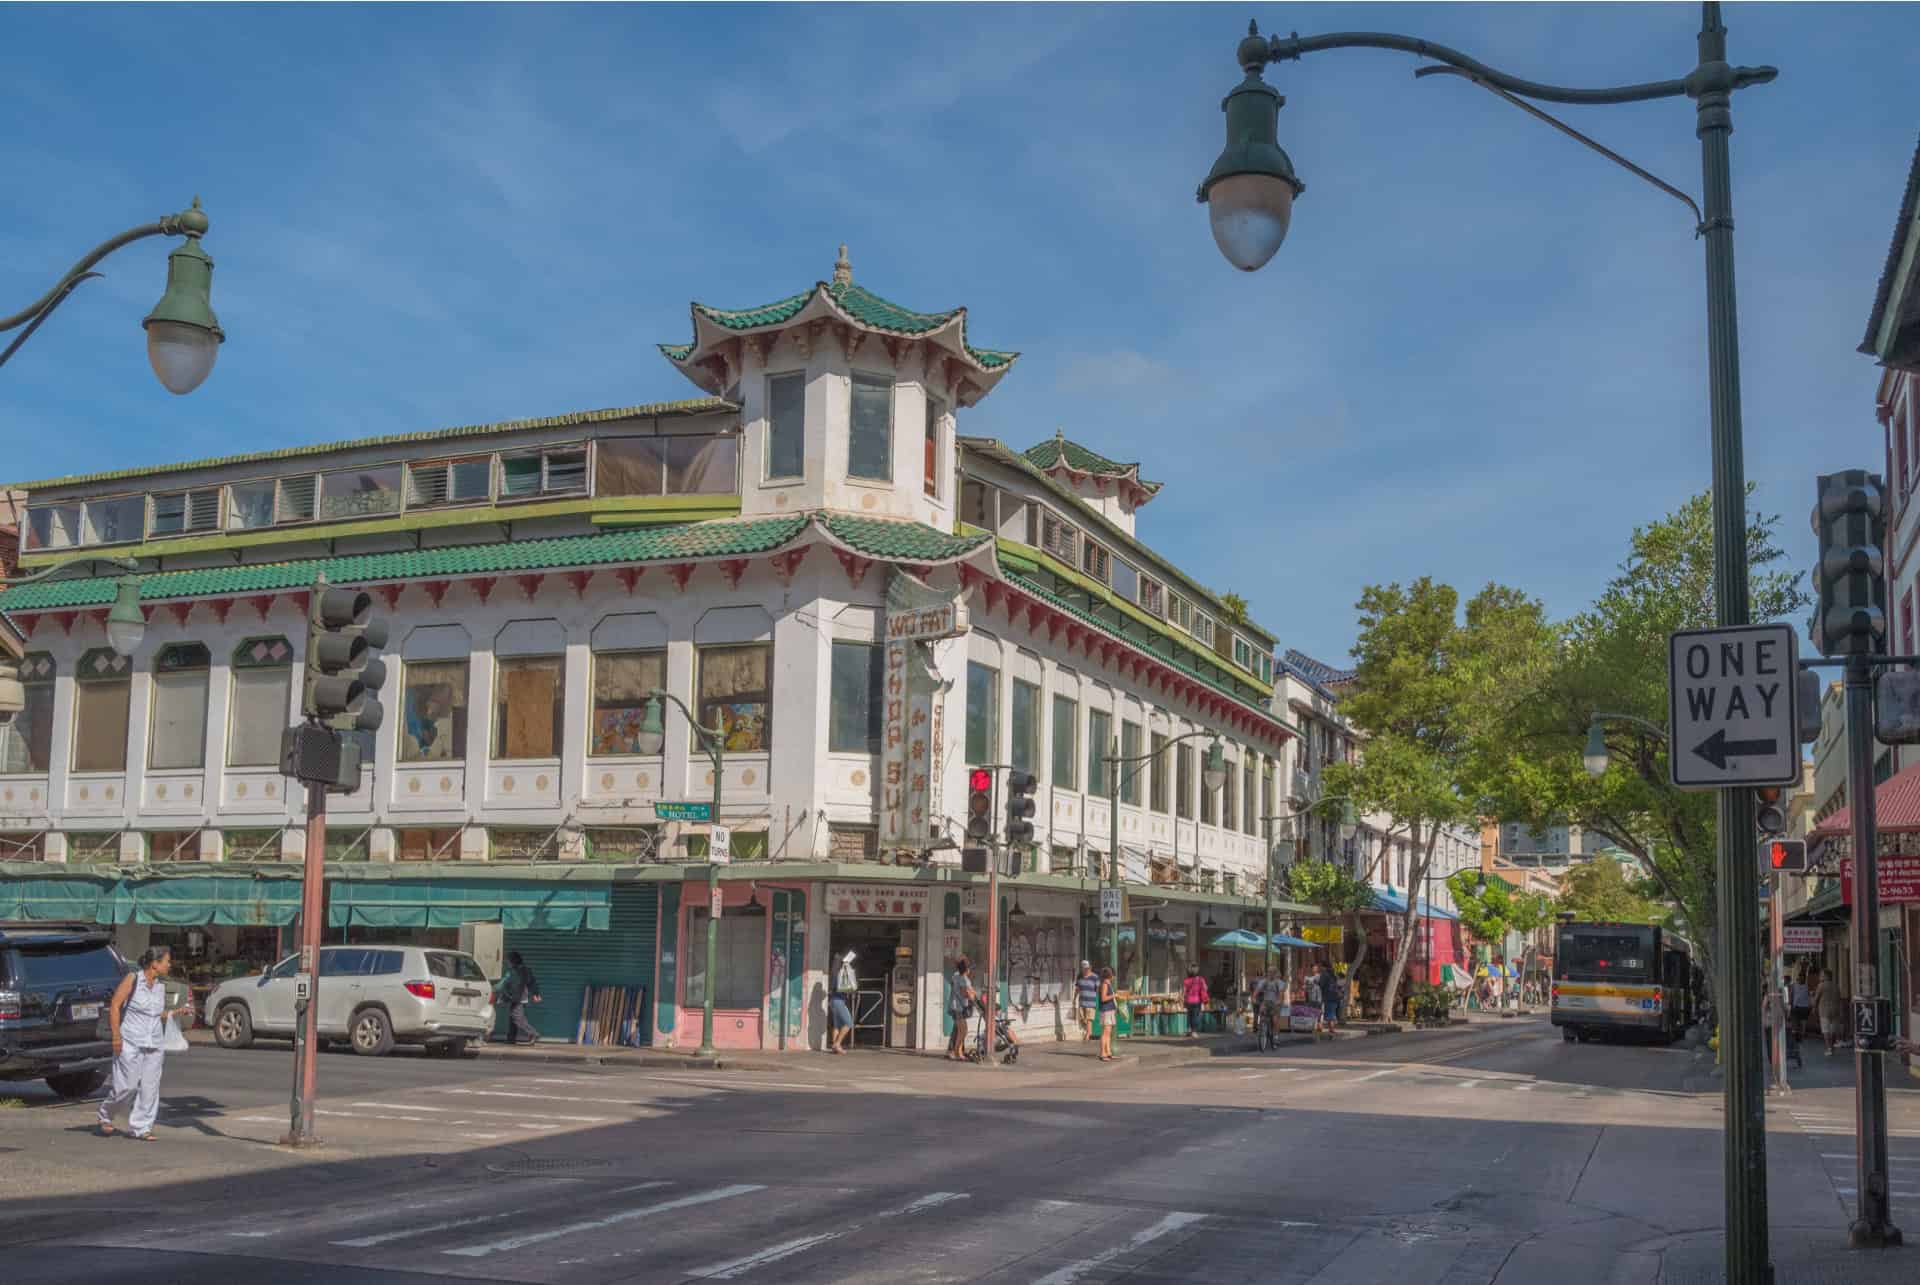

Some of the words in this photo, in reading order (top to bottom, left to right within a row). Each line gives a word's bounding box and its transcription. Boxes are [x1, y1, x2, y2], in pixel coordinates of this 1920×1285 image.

[1686, 640, 1777, 679] ONE
[886, 648, 904, 749] CHOP
[1686, 683, 1779, 721] WAY
[885, 760, 902, 834] SUI
[668, 811, 697, 819] HOTEL
[715, 831, 726, 843] NO
[1103, 890, 1120, 900] ONE
[1103, 901, 1120, 910] WAY
